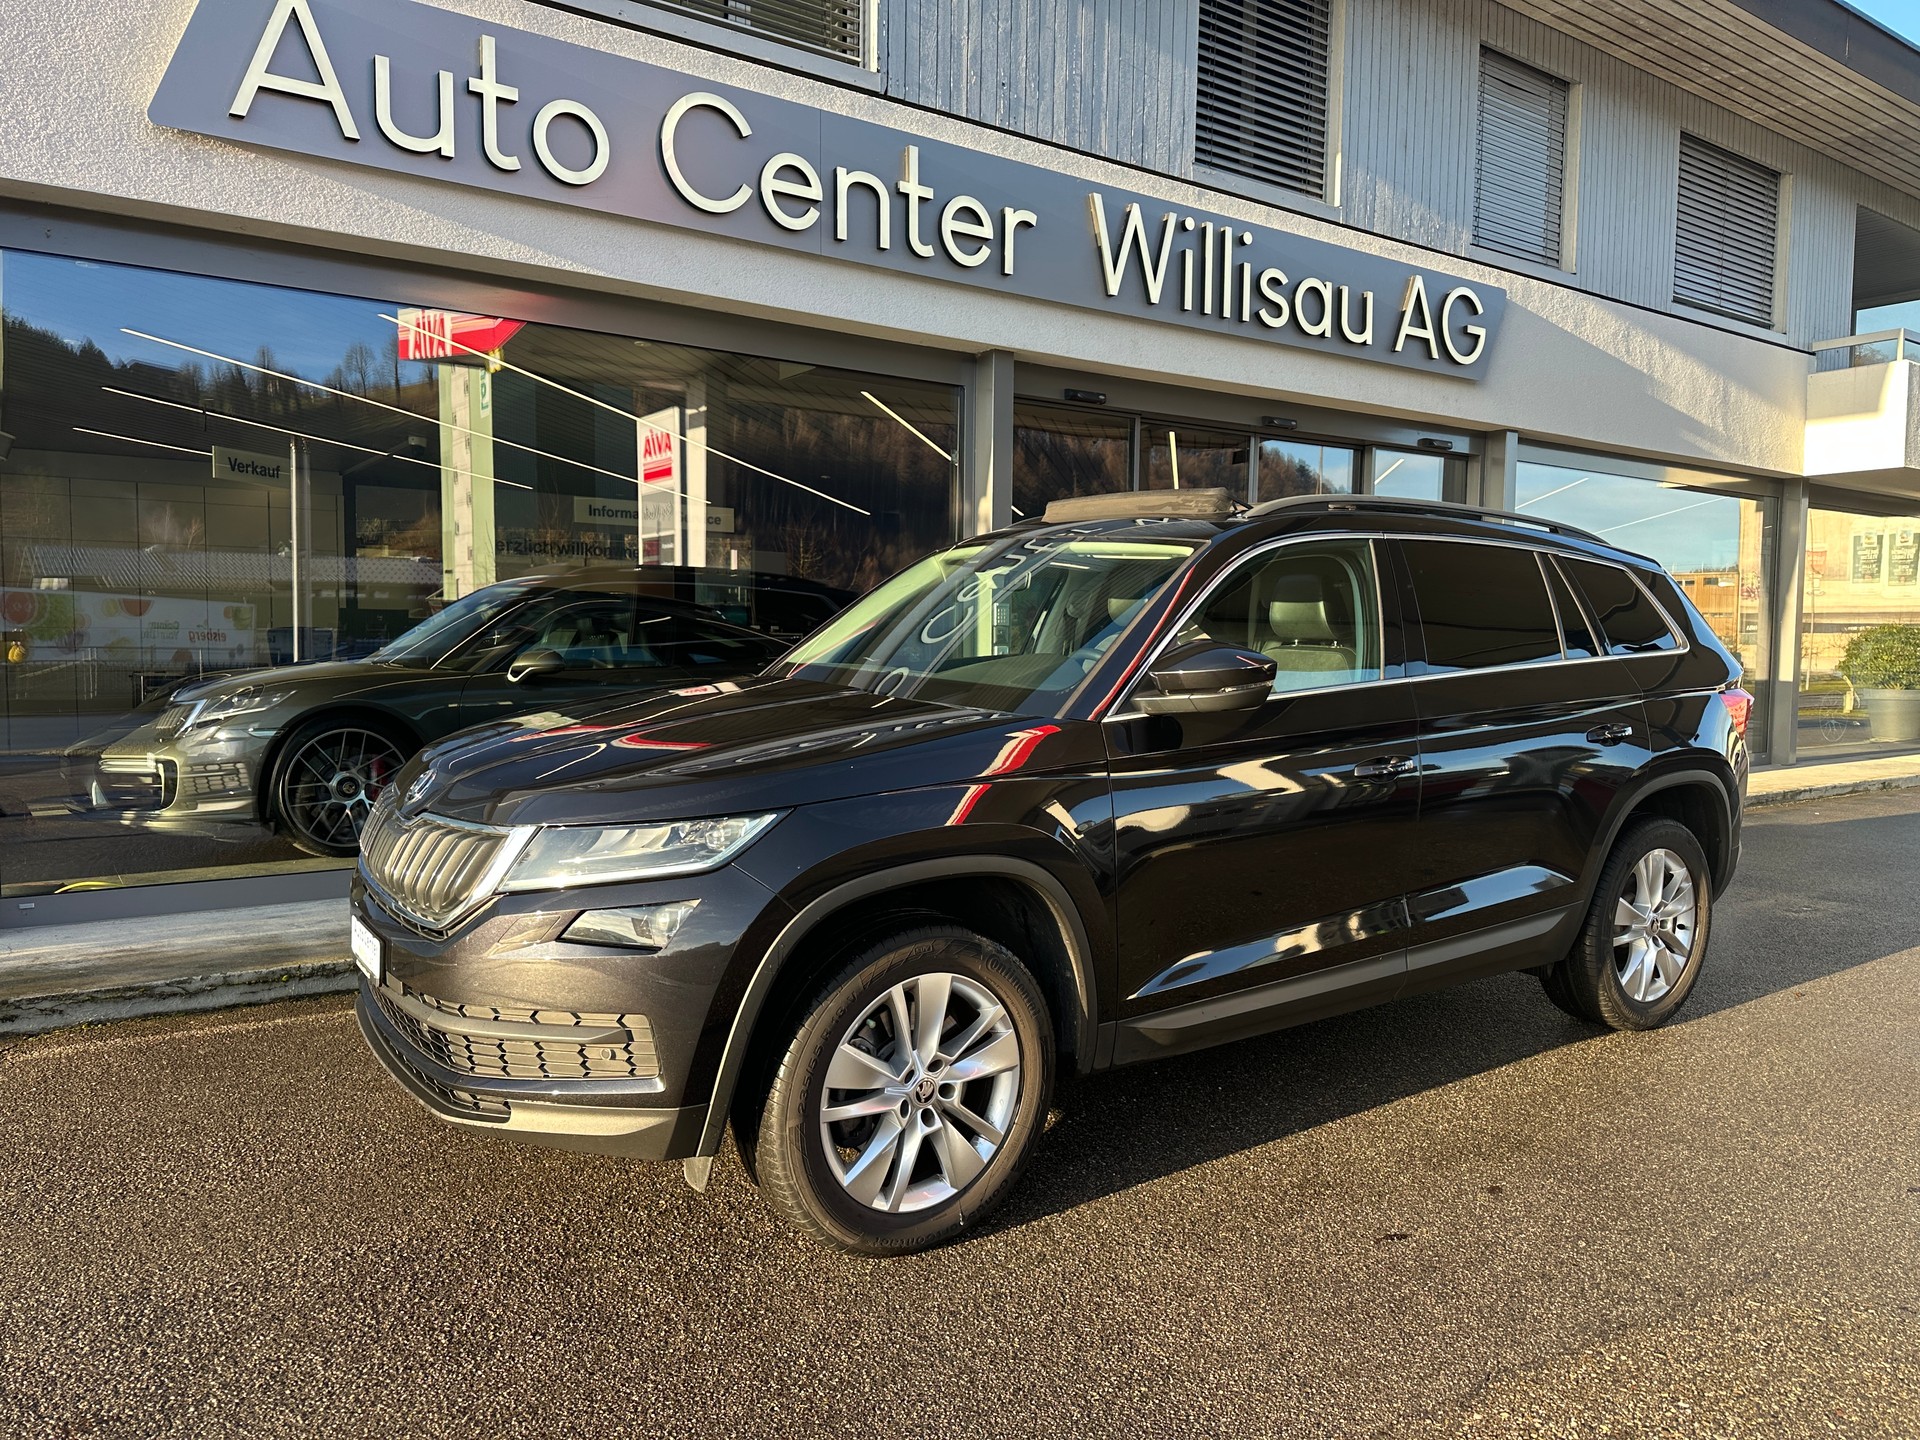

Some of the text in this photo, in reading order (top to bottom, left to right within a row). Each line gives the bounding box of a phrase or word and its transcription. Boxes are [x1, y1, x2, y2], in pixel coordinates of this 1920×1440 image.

[228, 0, 1488, 366] Auto Center Willisau AG
[228, 456, 281, 478] Verkauf
[588, 503, 638, 520] Informa
[495, 538, 638, 561] erzlich willkome
